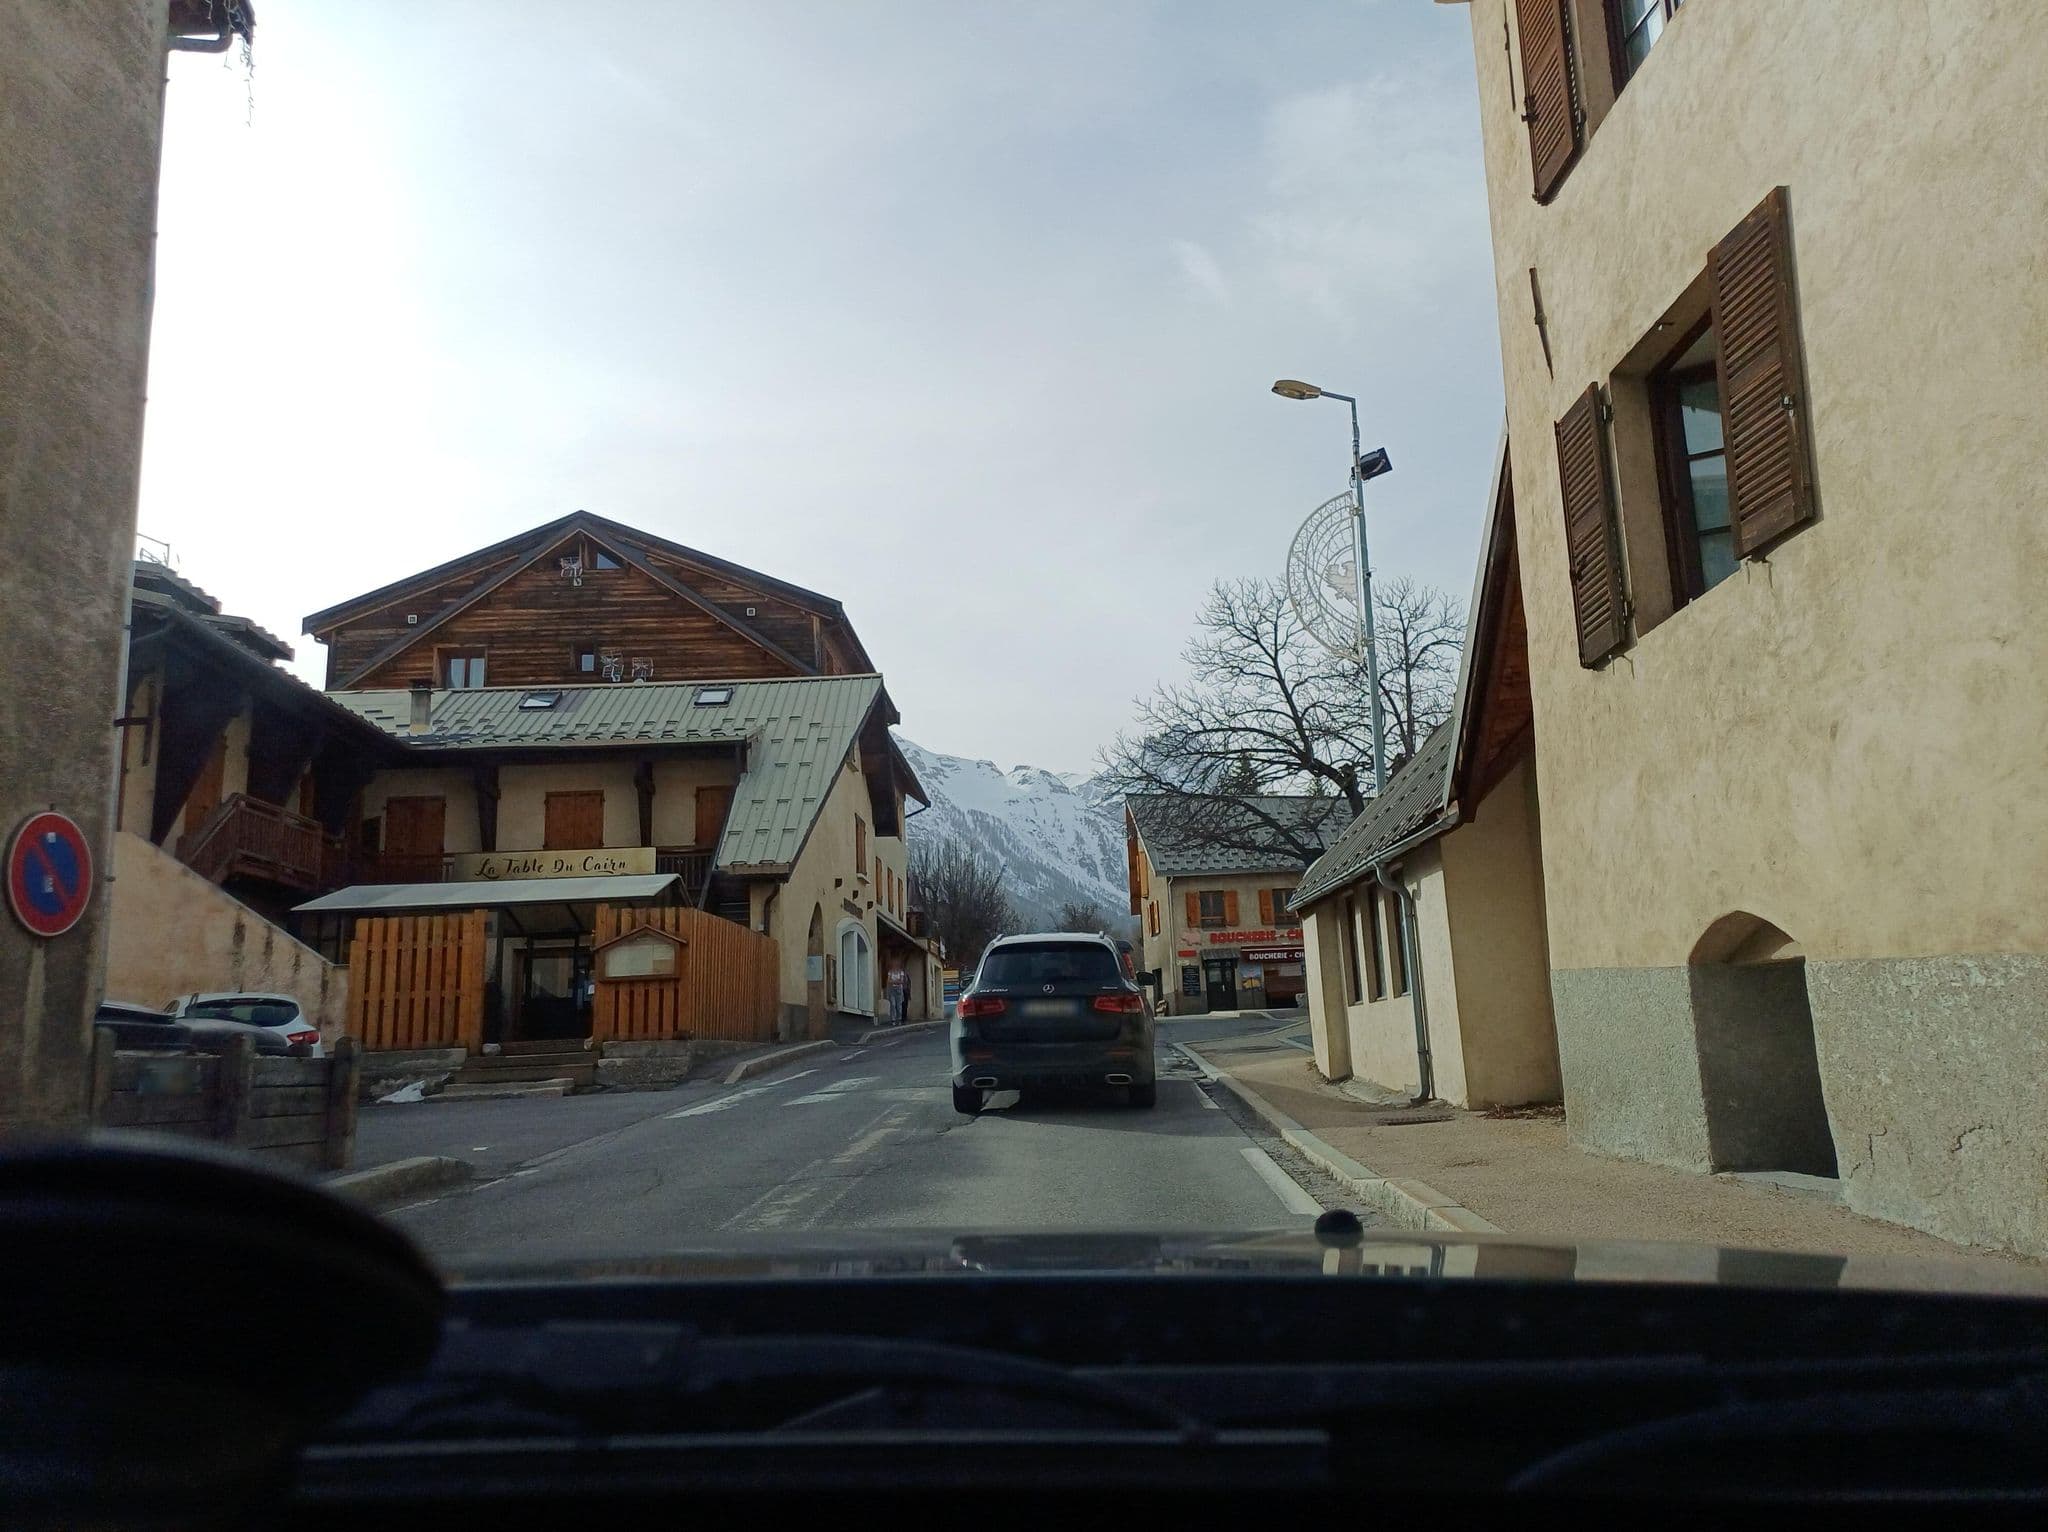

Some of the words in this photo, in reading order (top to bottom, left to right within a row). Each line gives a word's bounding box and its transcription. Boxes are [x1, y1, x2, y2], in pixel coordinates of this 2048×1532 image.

[475, 858, 500, 879] La
[503, 858, 544, 874] Table
[553, 859, 573, 874] Du
[582, 856, 627, 874] Cairn
[1210, 930, 1276, 944] BOUCHERIE
[1249, 952, 1288, 961] BOUCHERIE
